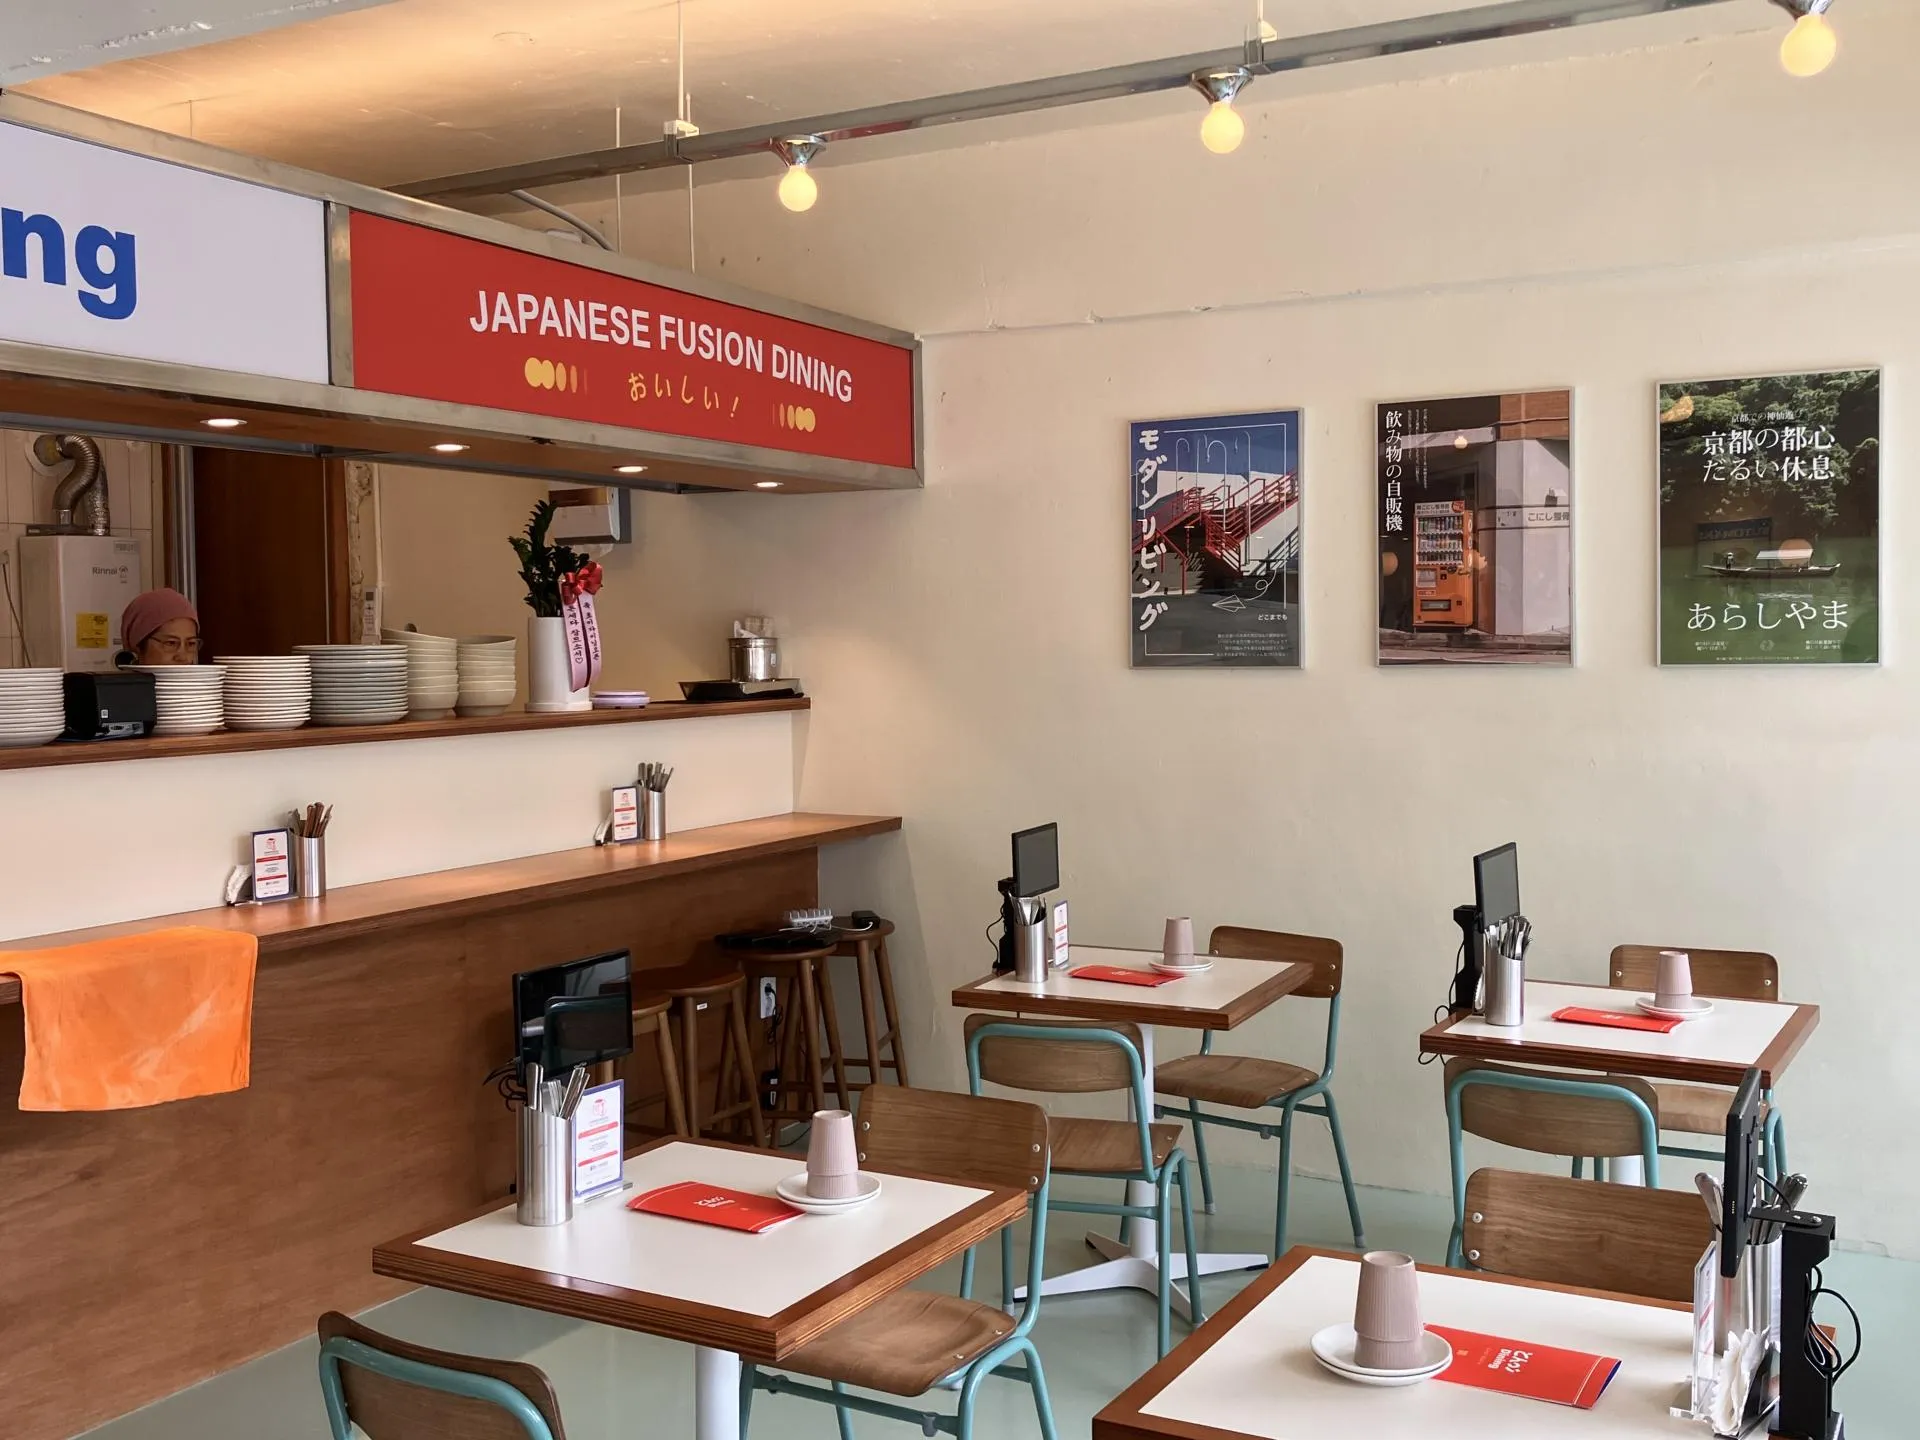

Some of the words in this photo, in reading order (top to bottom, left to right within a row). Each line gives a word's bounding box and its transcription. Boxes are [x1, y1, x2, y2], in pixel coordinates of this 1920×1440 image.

[469, 290, 651, 348] JAPANESE
[659, 314, 763, 373] FUSION
[771, 345, 853, 402] DINING
[1701, 425, 1836, 456] 京都の都心
[1385, 410, 1403, 531] 飲み物の自販機
[1702, 455, 1835, 483] だるい休息
[1139, 429, 1168, 631] モダンリビング
[92, 566, 118, 576] Rinnai
[1257, 613, 1288, 621] どこまでも
[1687, 600, 1849, 632] あらしやま
